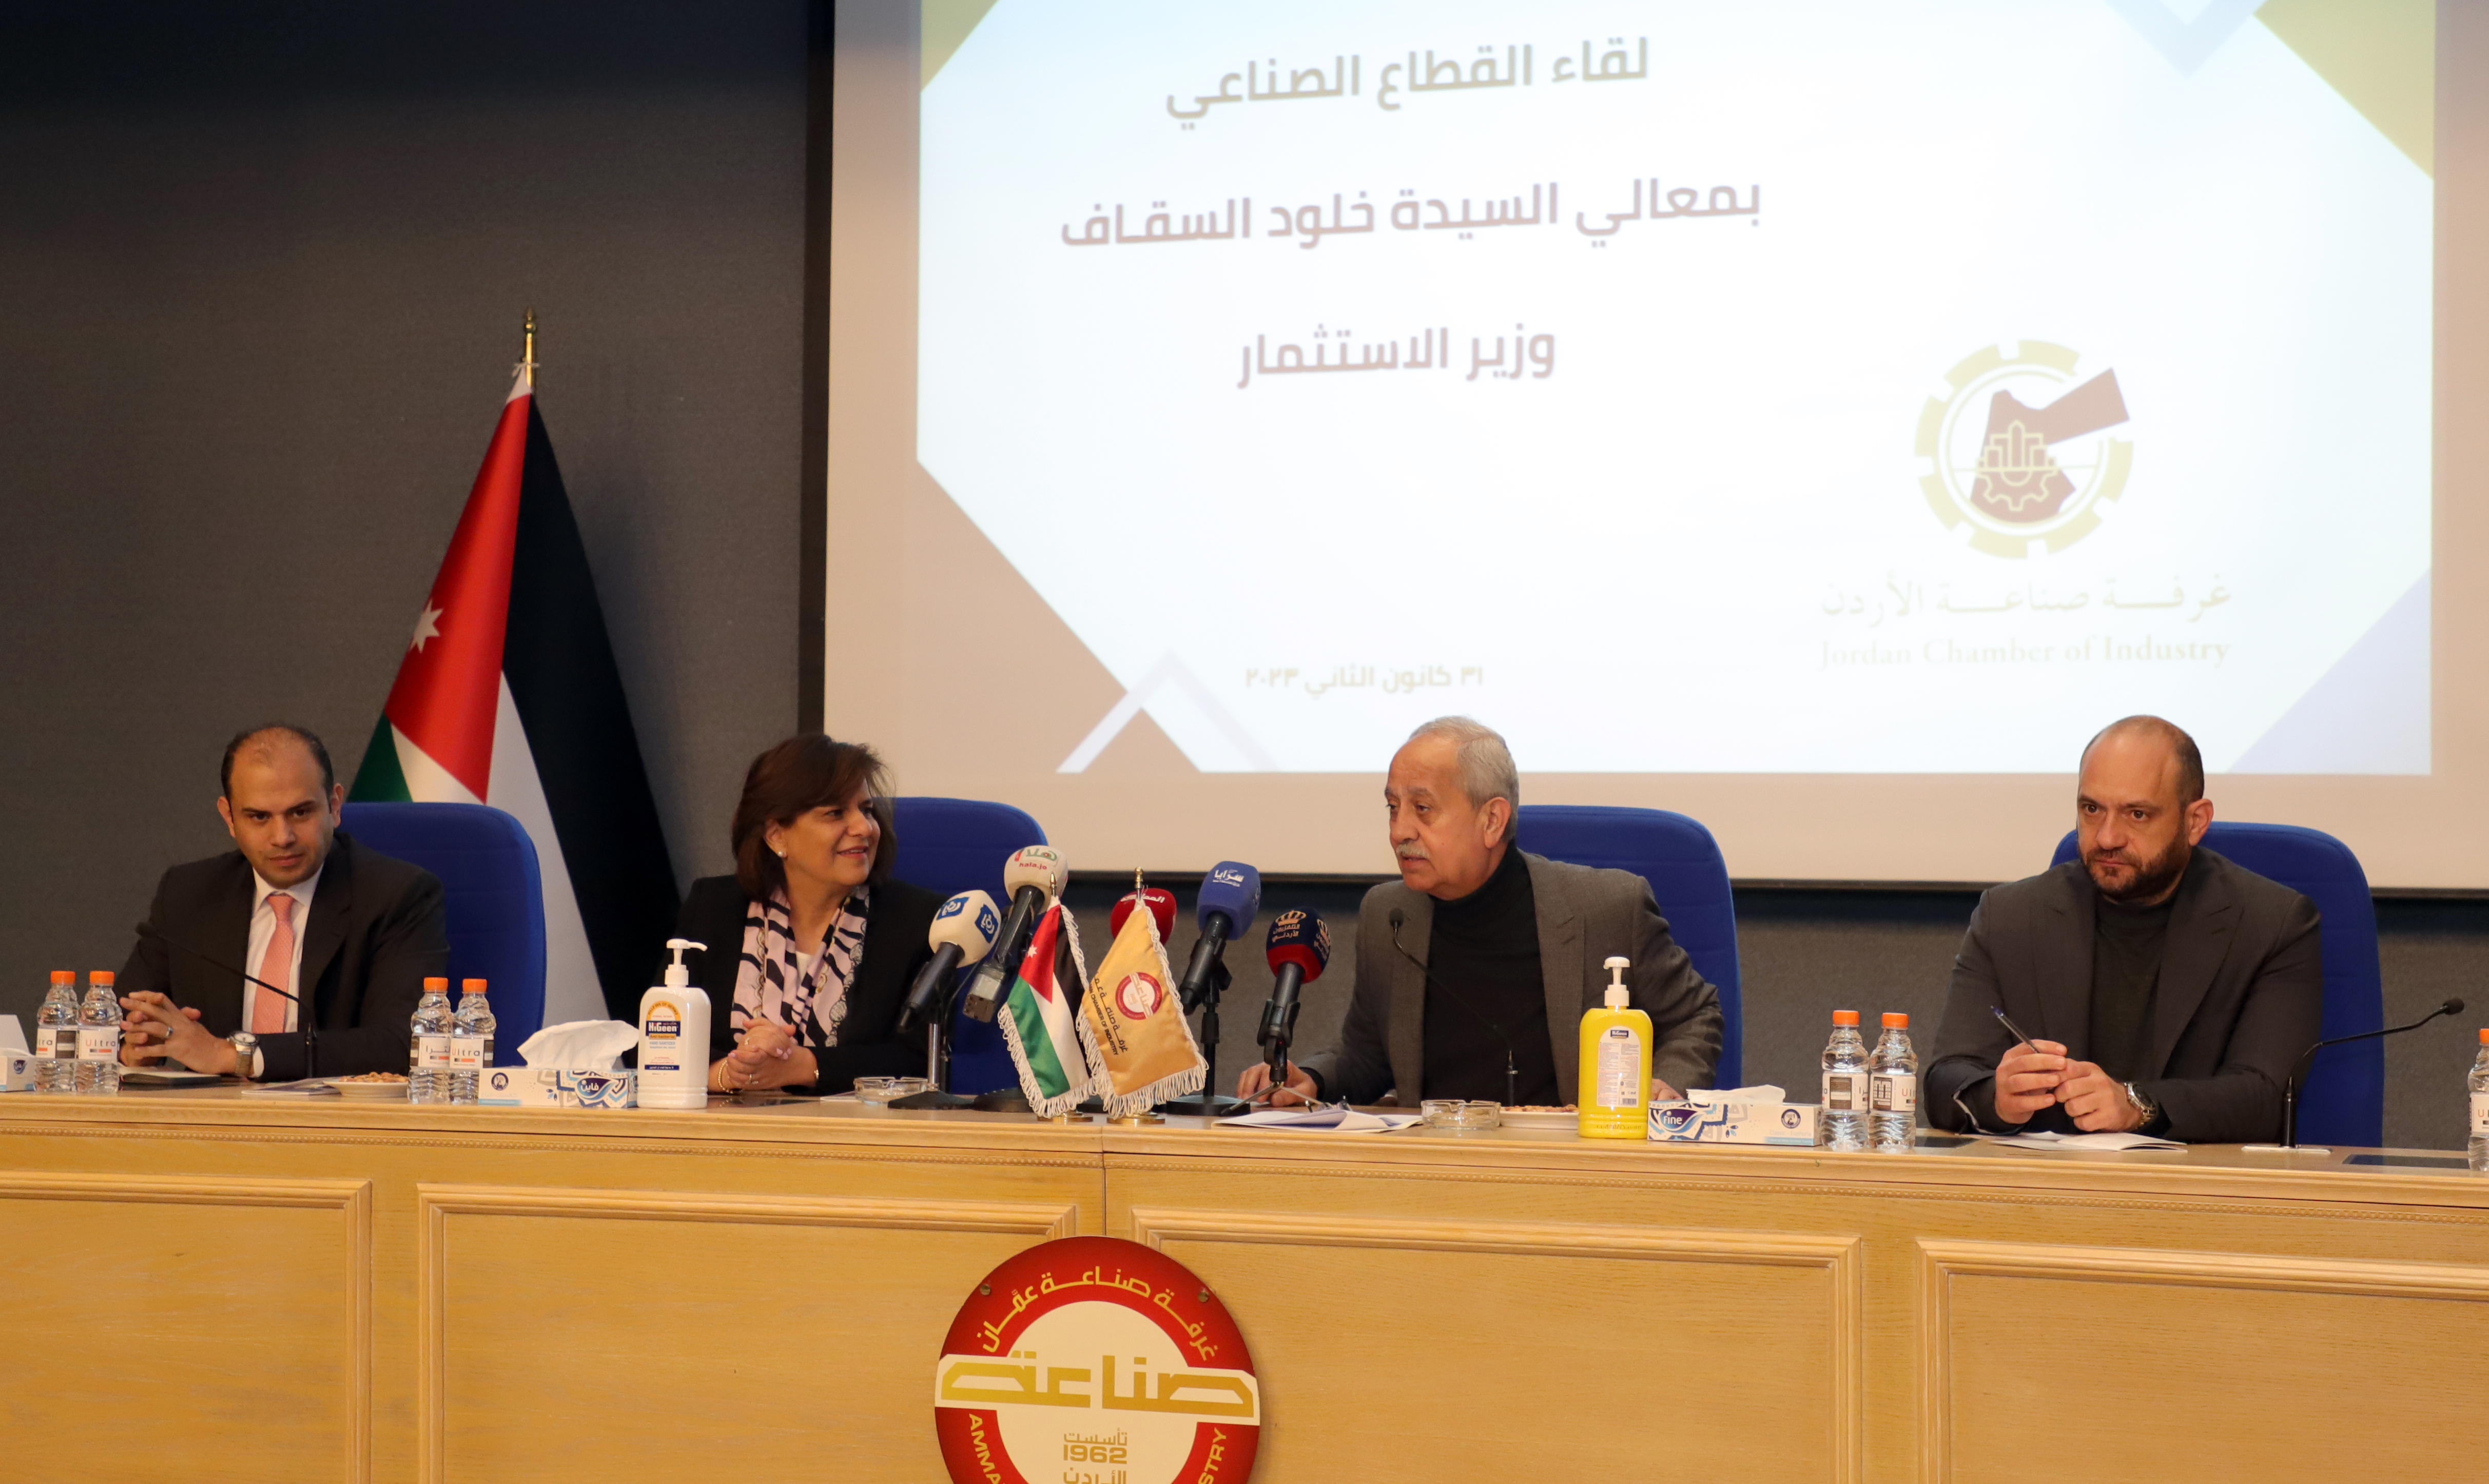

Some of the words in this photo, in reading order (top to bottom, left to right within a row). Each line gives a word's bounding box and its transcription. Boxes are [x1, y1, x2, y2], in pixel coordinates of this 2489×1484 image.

[1376, 43, 1534, 112] القطاع
[1550, 35, 1649, 84] لقاء
[1165, 53, 1362, 131] الصناعي
[1061, 197, 1252, 246] السقاف
[1267, 190, 1375, 250] خلود
[1390, 181, 1559, 240] السيدة
[1575, 177, 1761, 248] بمعالي
[1236, 323, 1449, 389] الاستثمار
[1465, 322, 1555, 381] وزير
[1821, 570, 1923, 628] الأردن
[1936, 579, 2090, 613] صناعة
[2102, 571, 2232, 623] غرفة
[1820, 639, 1911, 670] Jordan
[1922, 636, 2055, 664] Chamber
[2064, 634, 2097, 661] of
[2104, 633, 2232, 668] Industry
[1305, 661, 1375, 700] الثاني
[1382, 664, 1452, 694] كانون
[1214, 869, 1244, 883] سرايا
[85, 1039, 116, 1047] Ultra
[1091, 994, 1104, 1022] CHAMBER
[1104, 1029, 1119, 1056] INDUSTRY
[452, 1047, 480, 1057] Ultra
[1663, 1110, 1683, 1125] fine
[1040, 1265, 1151, 1298] صناعة
[1153, 1288, 1219, 1361] غرفة
[969, 1413, 1005, 1484] AMMA
[1063, 1427, 1128, 1446] تأسست
[1063, 1444, 1127, 1464] 1962
[1197, 1427, 1227, 1484] STRY
